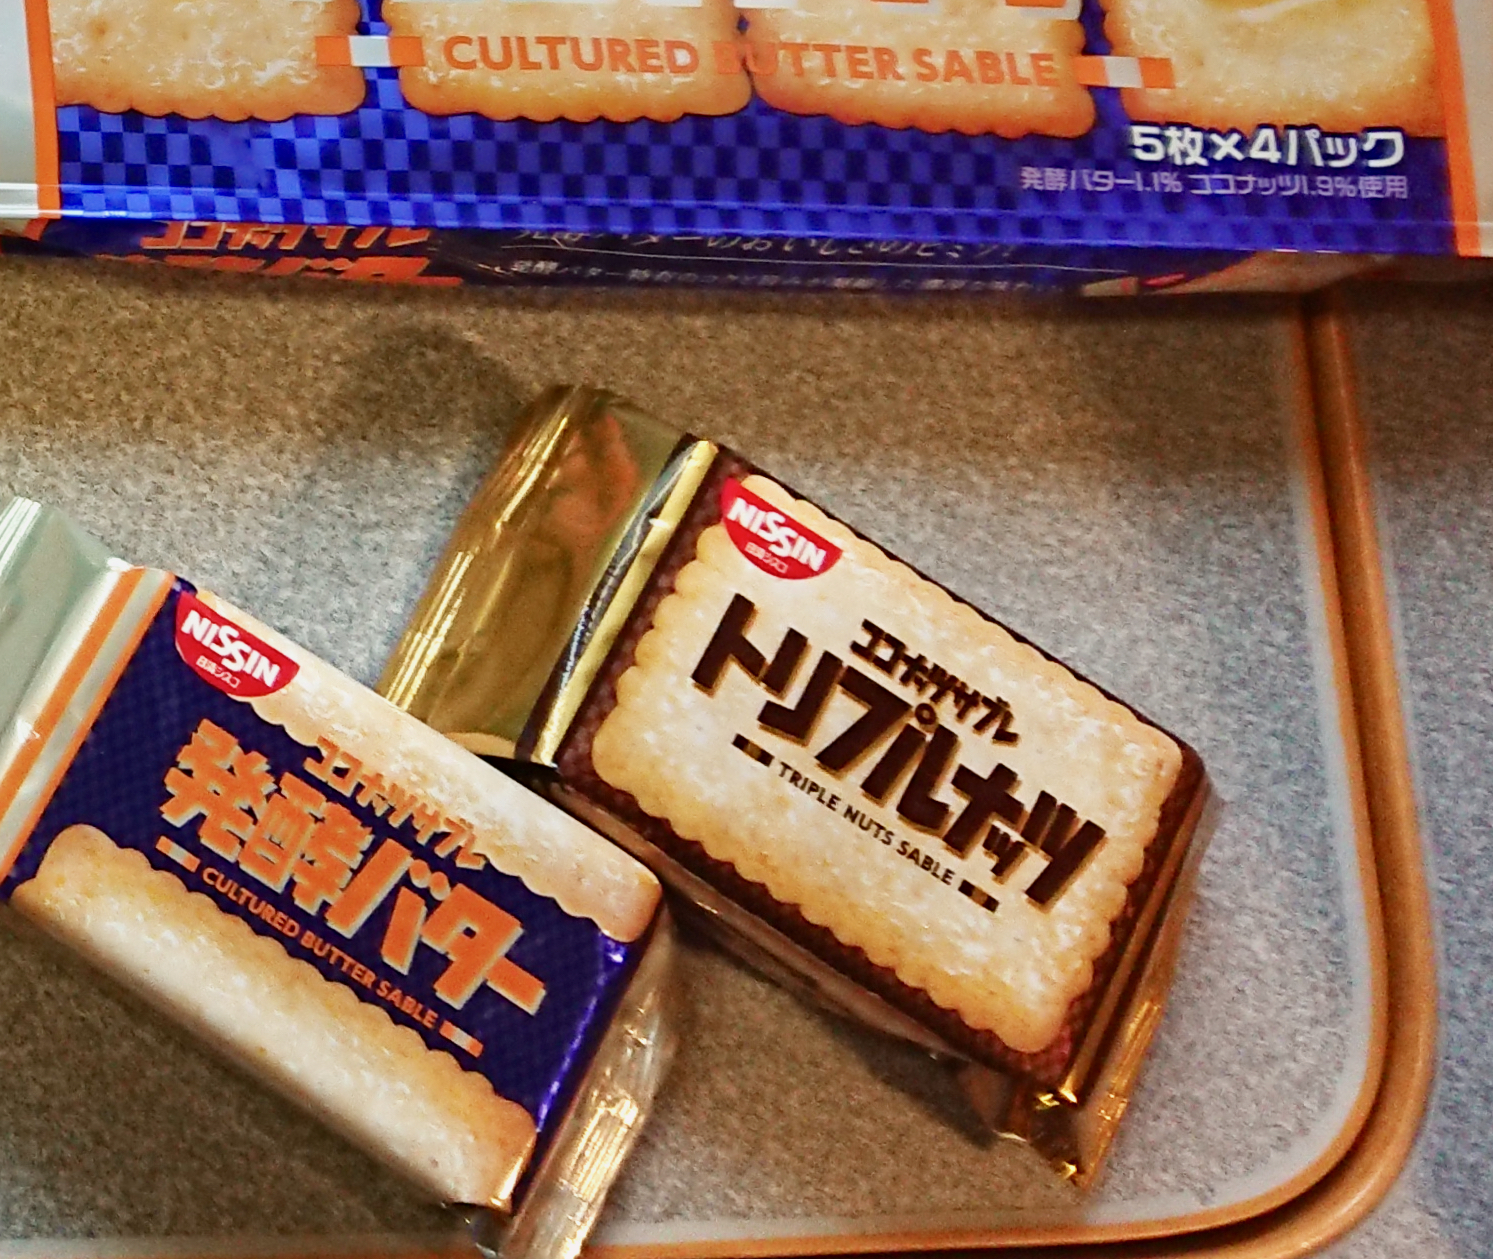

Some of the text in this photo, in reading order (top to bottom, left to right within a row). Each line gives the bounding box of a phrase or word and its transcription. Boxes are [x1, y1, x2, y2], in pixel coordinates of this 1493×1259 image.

[443, 34, 702, 76] CULTURED
[916, 47, 1062, 88] SABLE
[1130, 124, 1406, 169] 5枚×4パック
[726, 496, 827, 572] NISSIN
[180, 609, 281, 689] NISSIN
[849, 617, 1021, 745] ココナッツサブレ
[302, 734, 487, 871] ココナッツサブレ
[690, 592, 1107, 909] トリプルナッツ
[159, 717, 547, 1016] 発酵バター
[777, 760, 957, 886] TRIPLE NUTS SABLE
[201, 867, 441, 1032] CULTURED BUTTER SABLE
